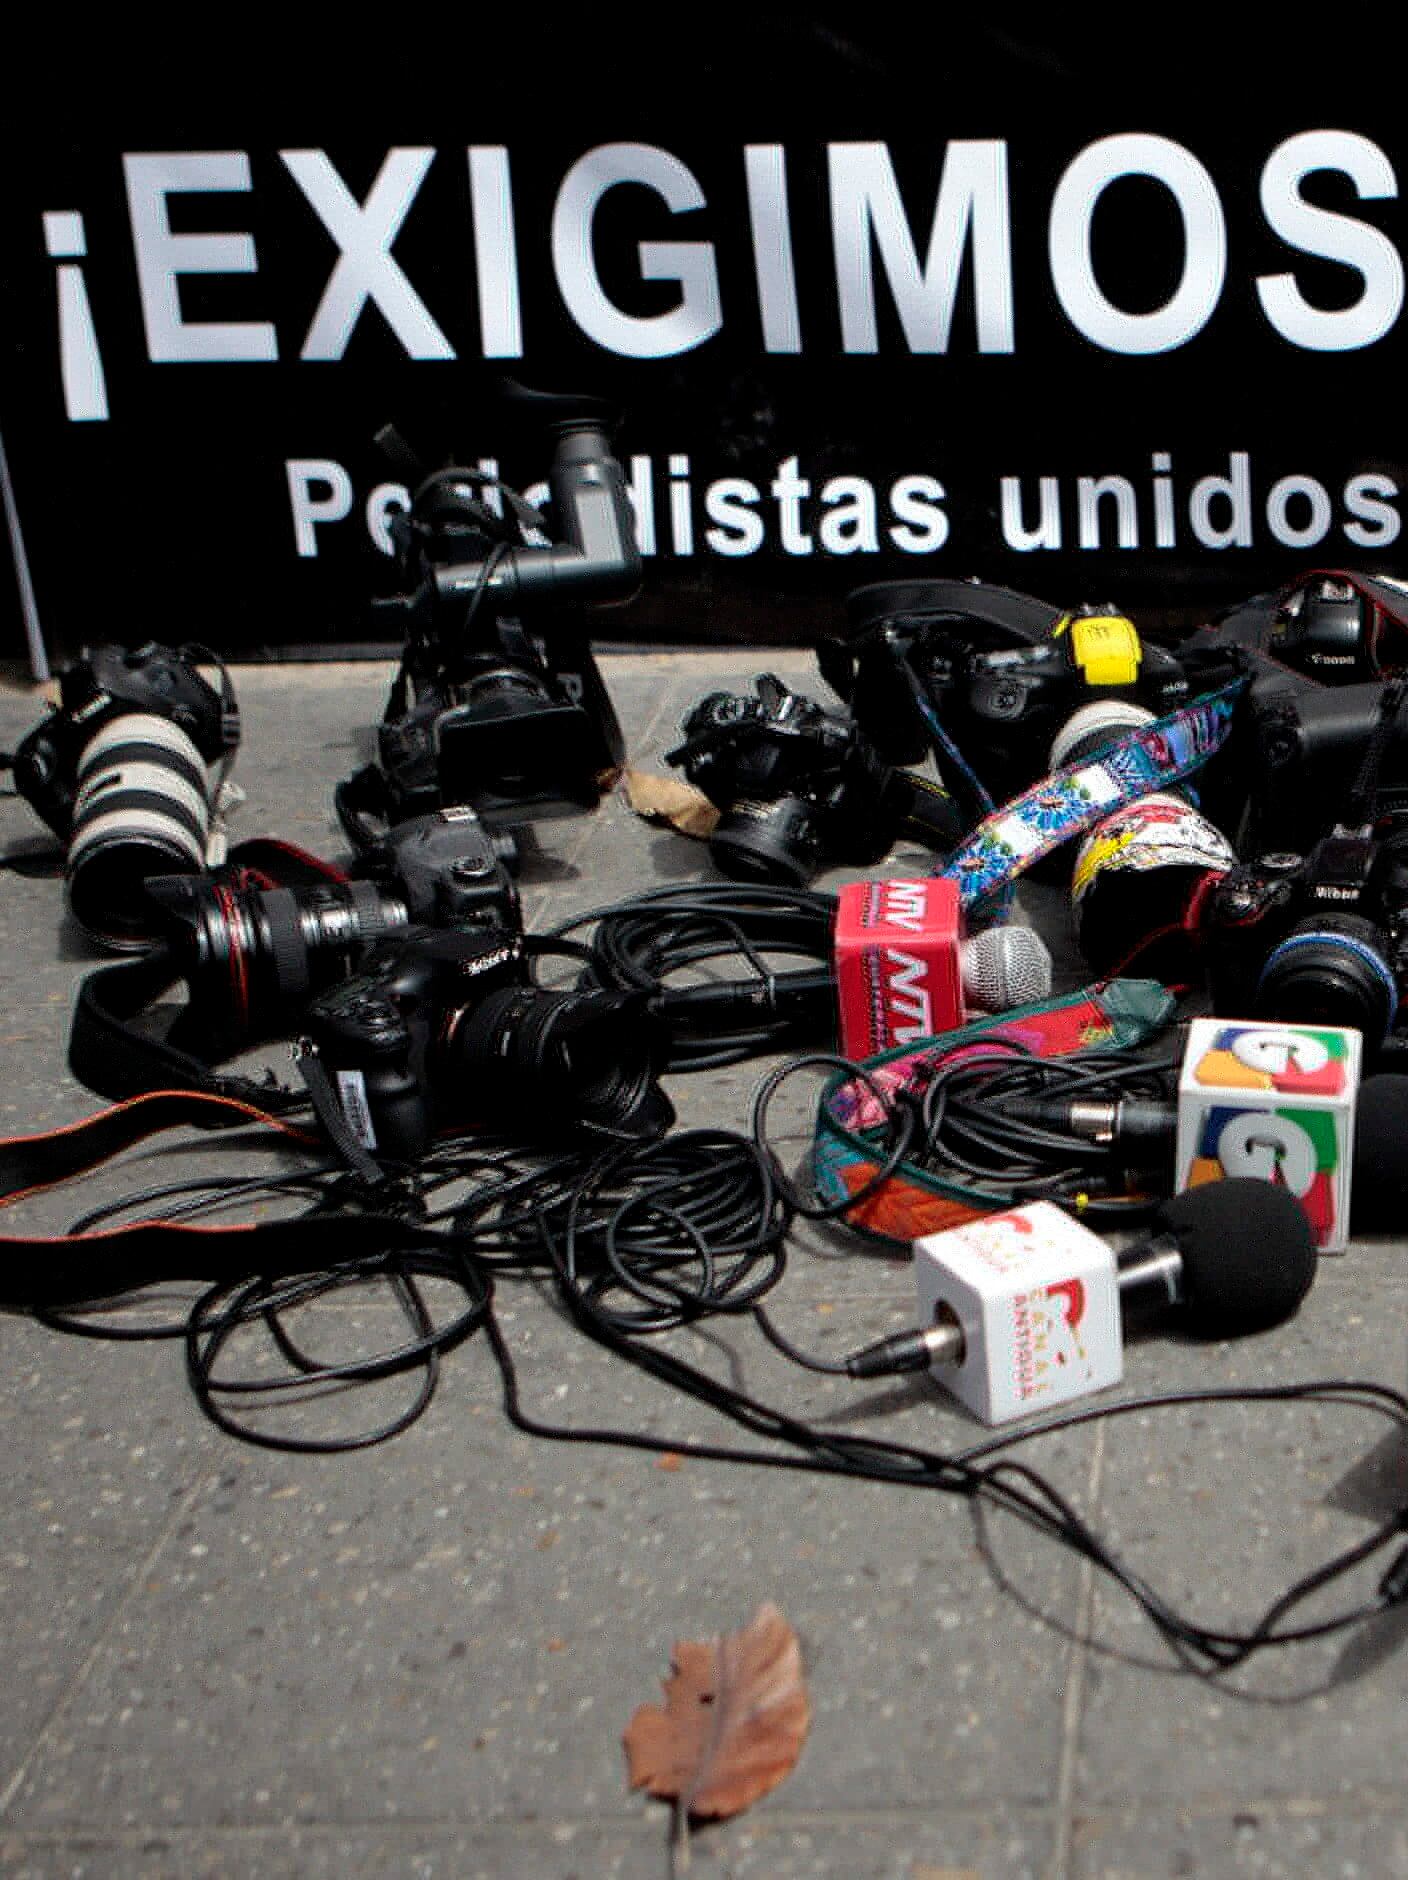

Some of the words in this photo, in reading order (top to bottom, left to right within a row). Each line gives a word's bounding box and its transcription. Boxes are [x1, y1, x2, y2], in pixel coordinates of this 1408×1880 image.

[43, 130, 1404, 421] ¡EXIGIMOS
[286, 455, 948, 557] Peistas
[1002, 453, 1400, 551] unidos
